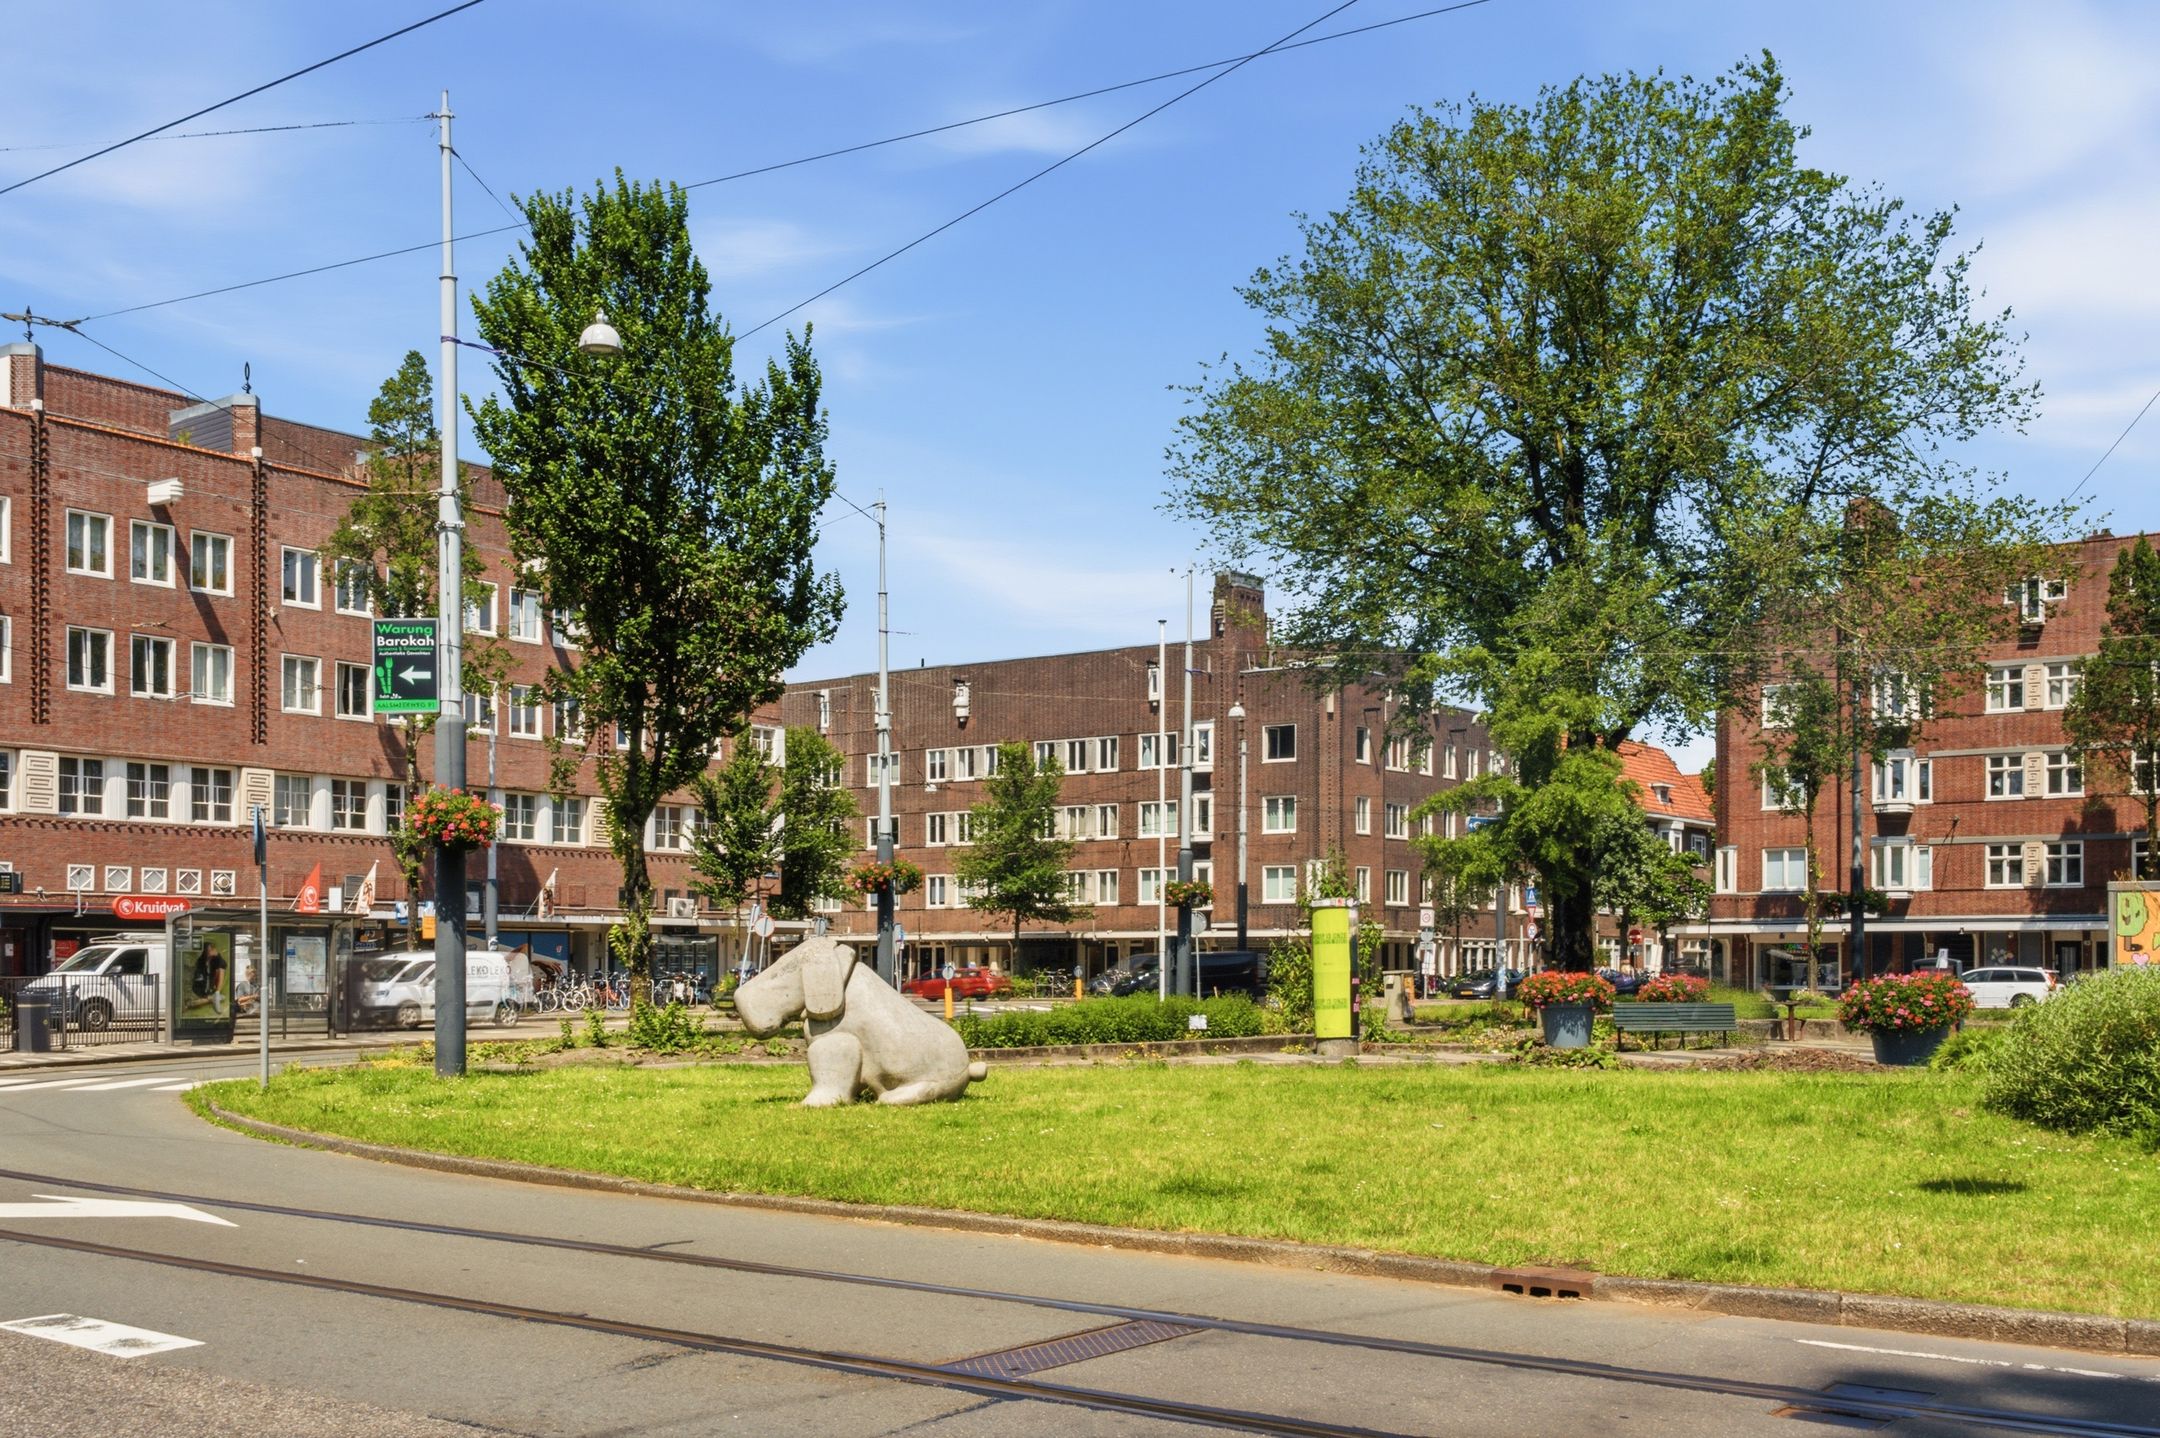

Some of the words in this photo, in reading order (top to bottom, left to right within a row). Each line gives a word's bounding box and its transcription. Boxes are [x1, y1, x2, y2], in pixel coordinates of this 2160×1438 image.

[377, 624, 433, 636] Warung
[377, 635, 434, 646] Barokah
[134, 901, 185, 914] Kruidvat
